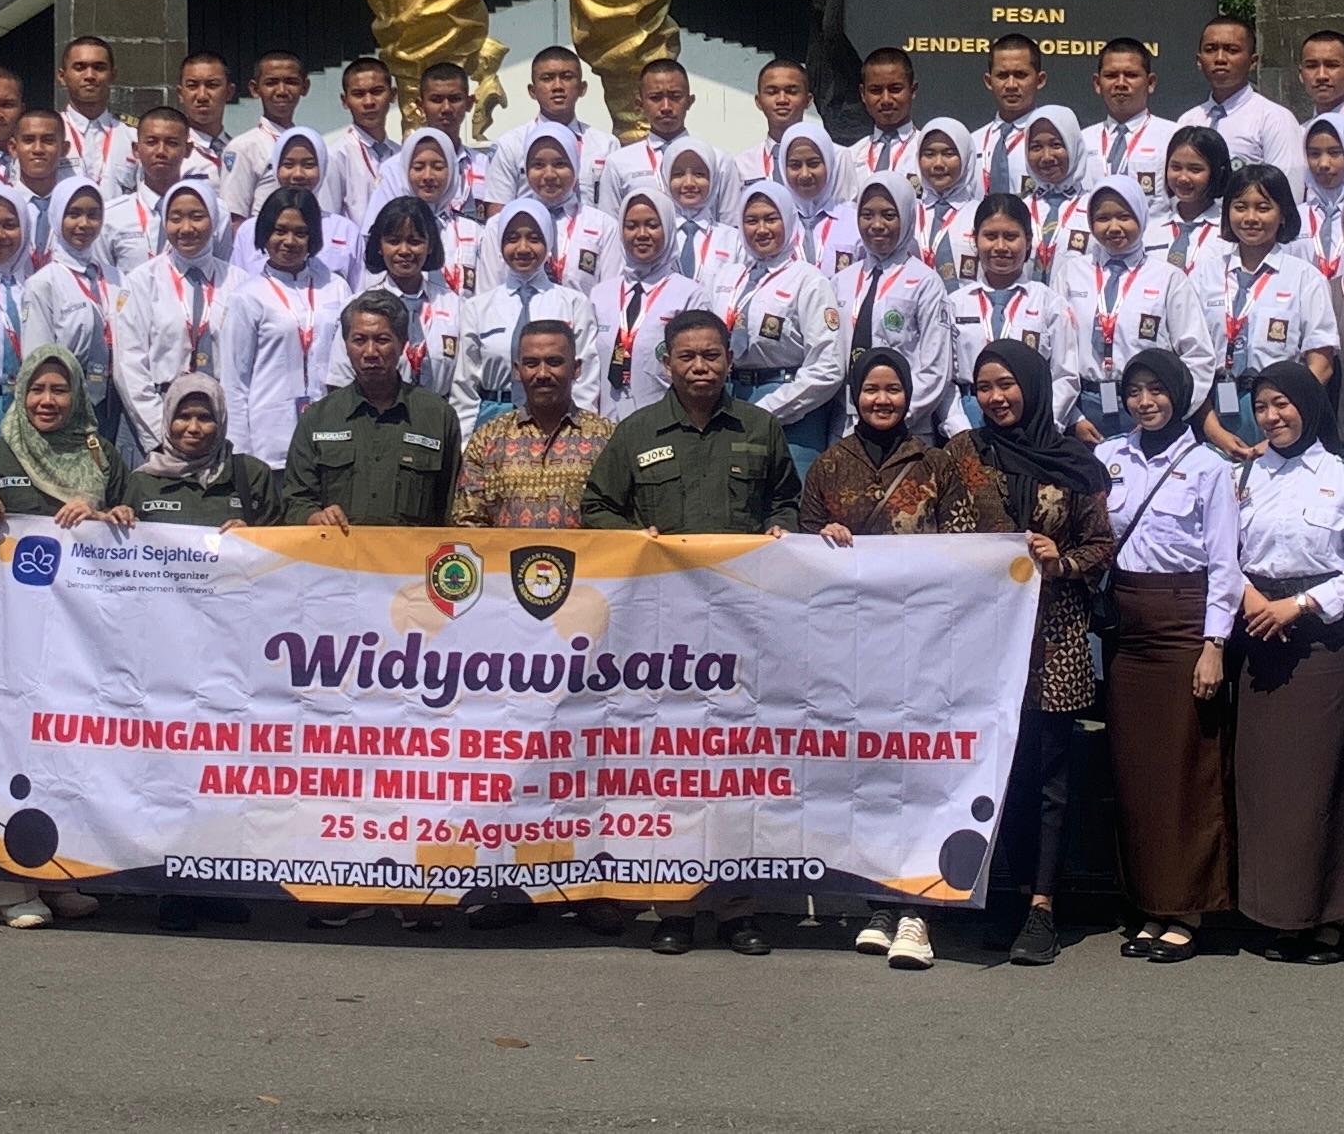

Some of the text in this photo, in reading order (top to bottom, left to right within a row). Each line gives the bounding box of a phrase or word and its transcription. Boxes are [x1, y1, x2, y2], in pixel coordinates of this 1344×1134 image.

[992, 8, 1065, 24] PESAN
[902, 37, 996, 54] JENDER
[71, 543, 218, 565] Mekarsari Sejahtera
[133, 570, 160, 578] Event
[163, 570, 209, 581] Organizer
[264, 632, 737, 708] Widyawisata
[32, 713, 977, 760] KUNJUNGAN KE MARKAS BESAR TNI ANGKATAN DARAT
[199, 766, 362, 796] AKADEMI
[374, 770, 512, 802] MILITER
[549, 771, 585, 799] DI
[597, 768, 791, 797] MAGELANG
[321, 813, 672, 848] 25 s.d 26 Agustus 2025
[166, 858, 824, 888] PASKIBRAKA TAHUN 2025 KABUPATEN MOJOKERTO
